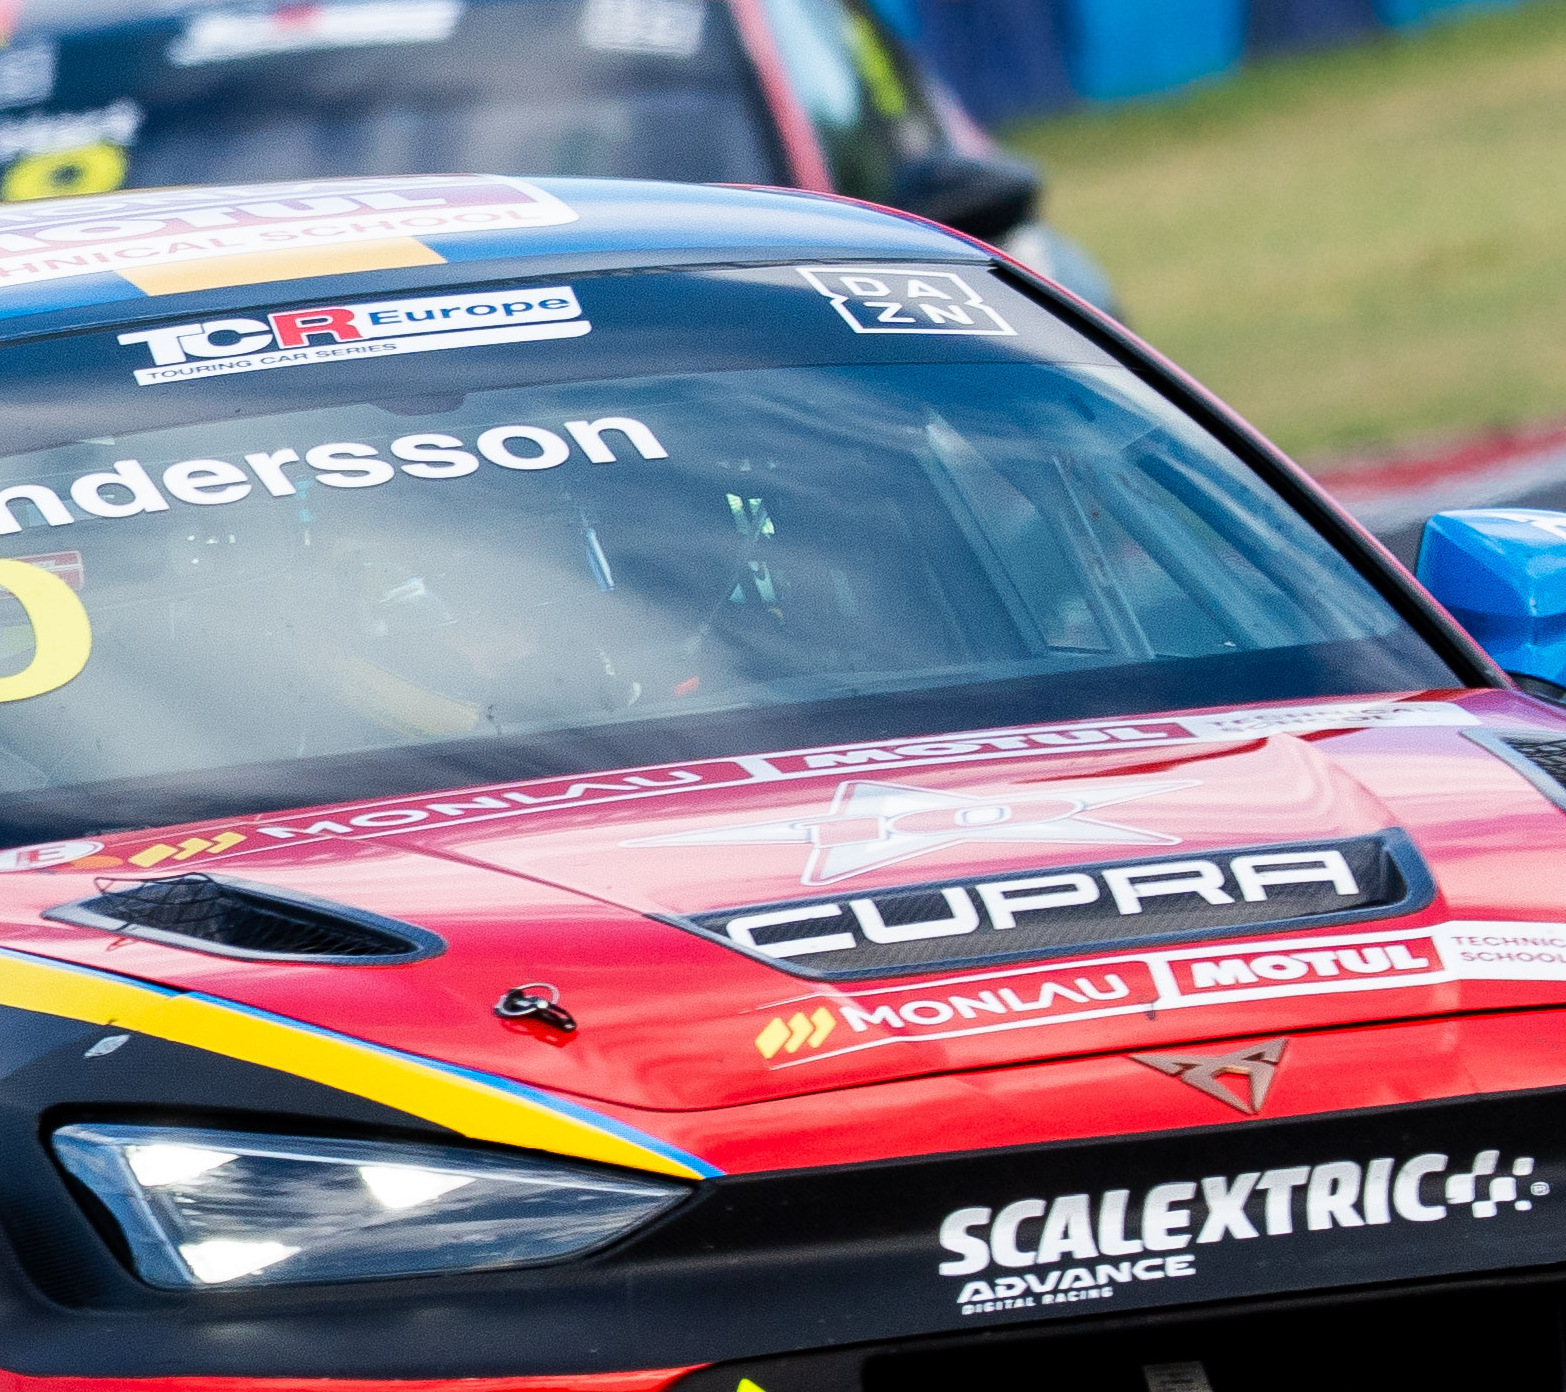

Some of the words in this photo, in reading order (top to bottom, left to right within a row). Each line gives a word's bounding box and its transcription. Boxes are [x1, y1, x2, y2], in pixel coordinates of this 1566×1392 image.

[266, 210, 548, 242] SCHOOL
[116, 308, 362, 367] TCR
[369, 292, 570, 326] Europe
[144, 357, 257, 381] TOURING
[262, 350, 326, 367] CAR
[331, 342, 397, 361] SERIES
[256, 769, 703, 839] MONLAU
[803, 726, 1164, 770] MOTUL
[727, 851, 1359, 956] CUPRA
[846, 973, 1129, 1033] MONLAU
[1193, 937, 1429, 988] MOTUL
[937, 1153, 1448, 1276] SCALEXTRIC
[957, 1255, 1196, 1304] ADVANCE
[961, 1297, 1036, 1315] DIGITAL
[1042, 1287, 1113, 1306] RACING
